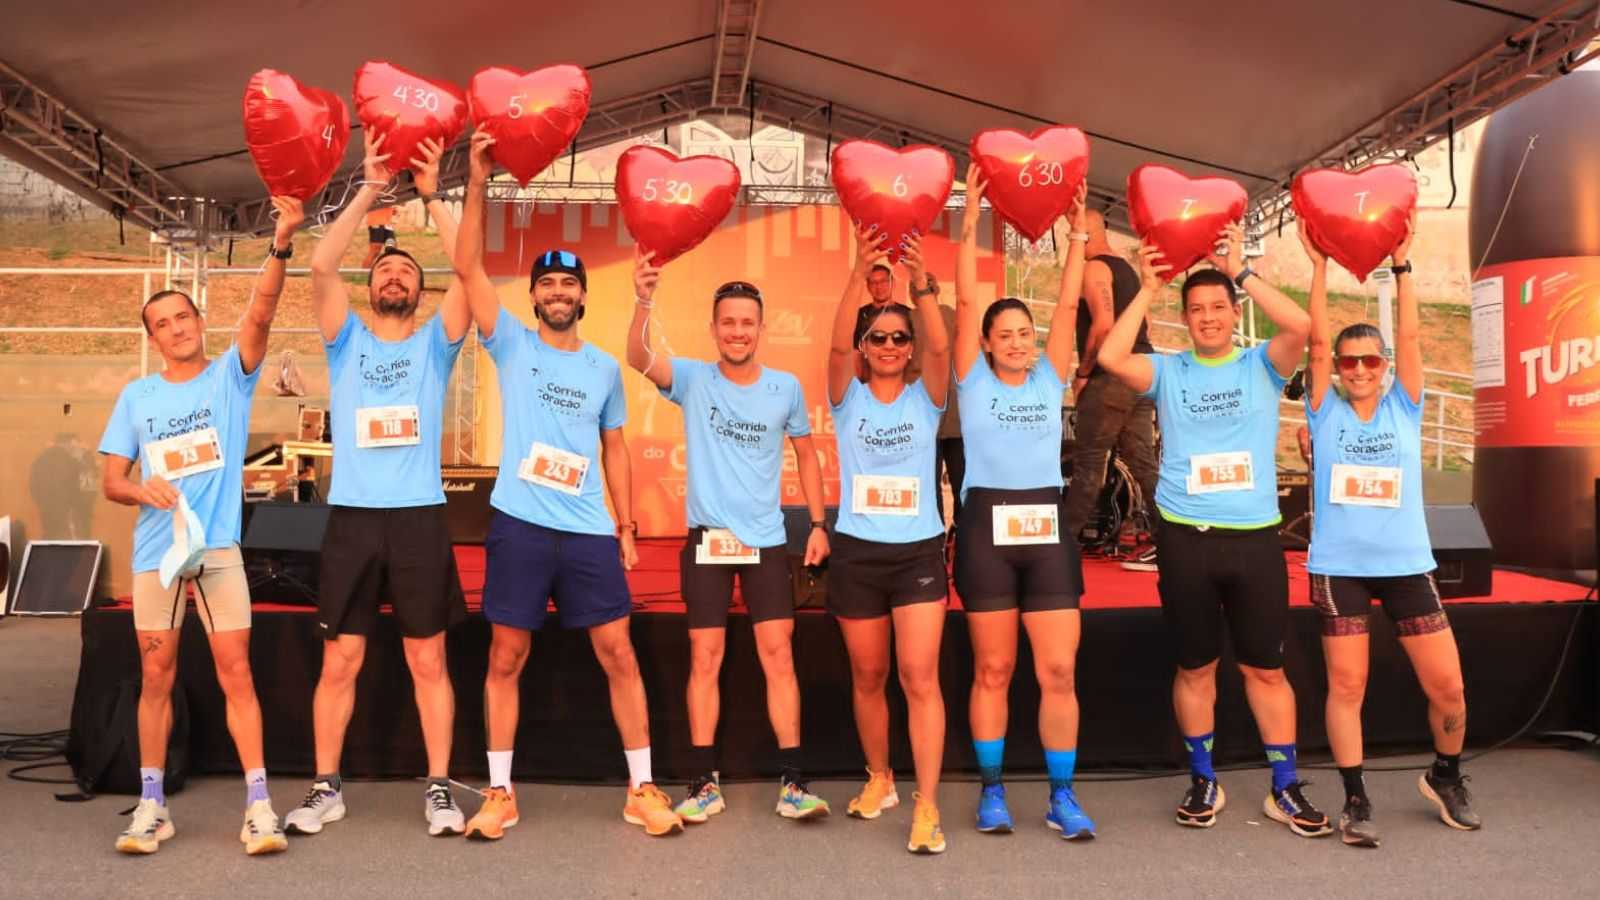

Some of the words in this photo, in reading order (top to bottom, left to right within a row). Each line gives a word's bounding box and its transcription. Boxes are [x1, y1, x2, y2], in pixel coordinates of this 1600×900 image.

[546, 382, 588, 401] Corrida
[727, 419, 768, 433] Corrida
[543, 460, 571, 481] 243
[1356, 479, 1384, 496] 754
